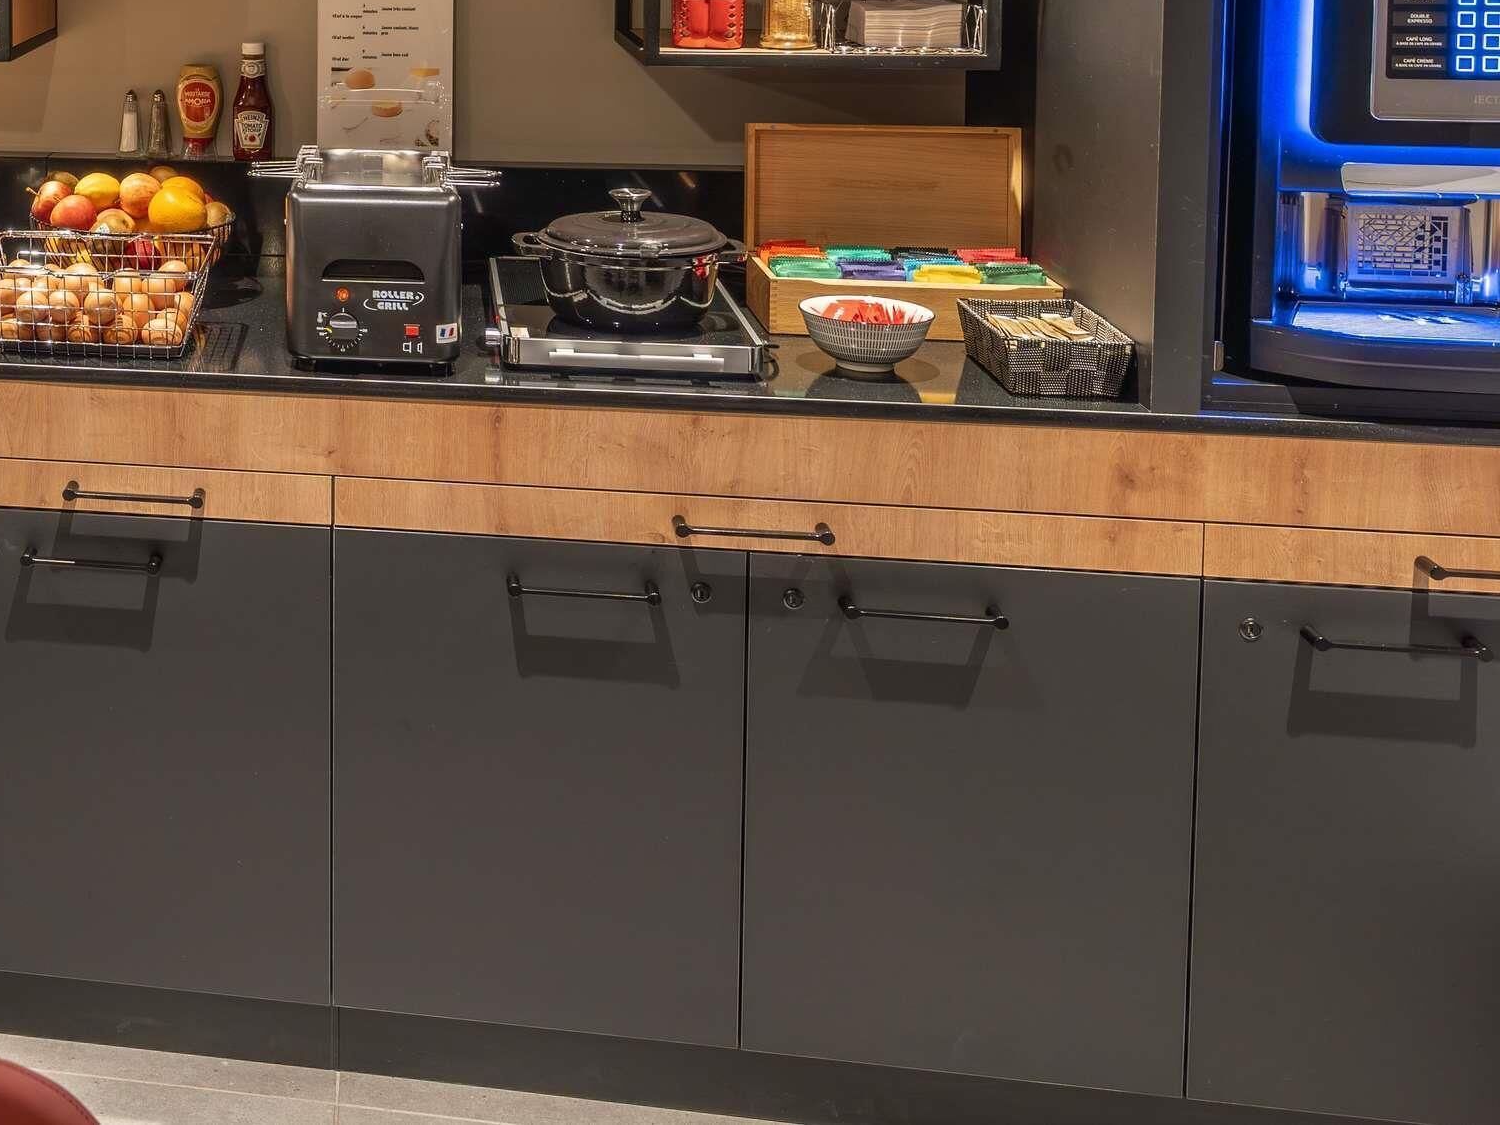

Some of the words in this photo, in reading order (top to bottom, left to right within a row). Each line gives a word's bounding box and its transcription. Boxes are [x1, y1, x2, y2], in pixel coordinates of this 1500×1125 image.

[1467, 94, 1500, 104] NECT
[372, 290, 414, 300] ROLLER
[377, 302, 409, 311] GRILL
